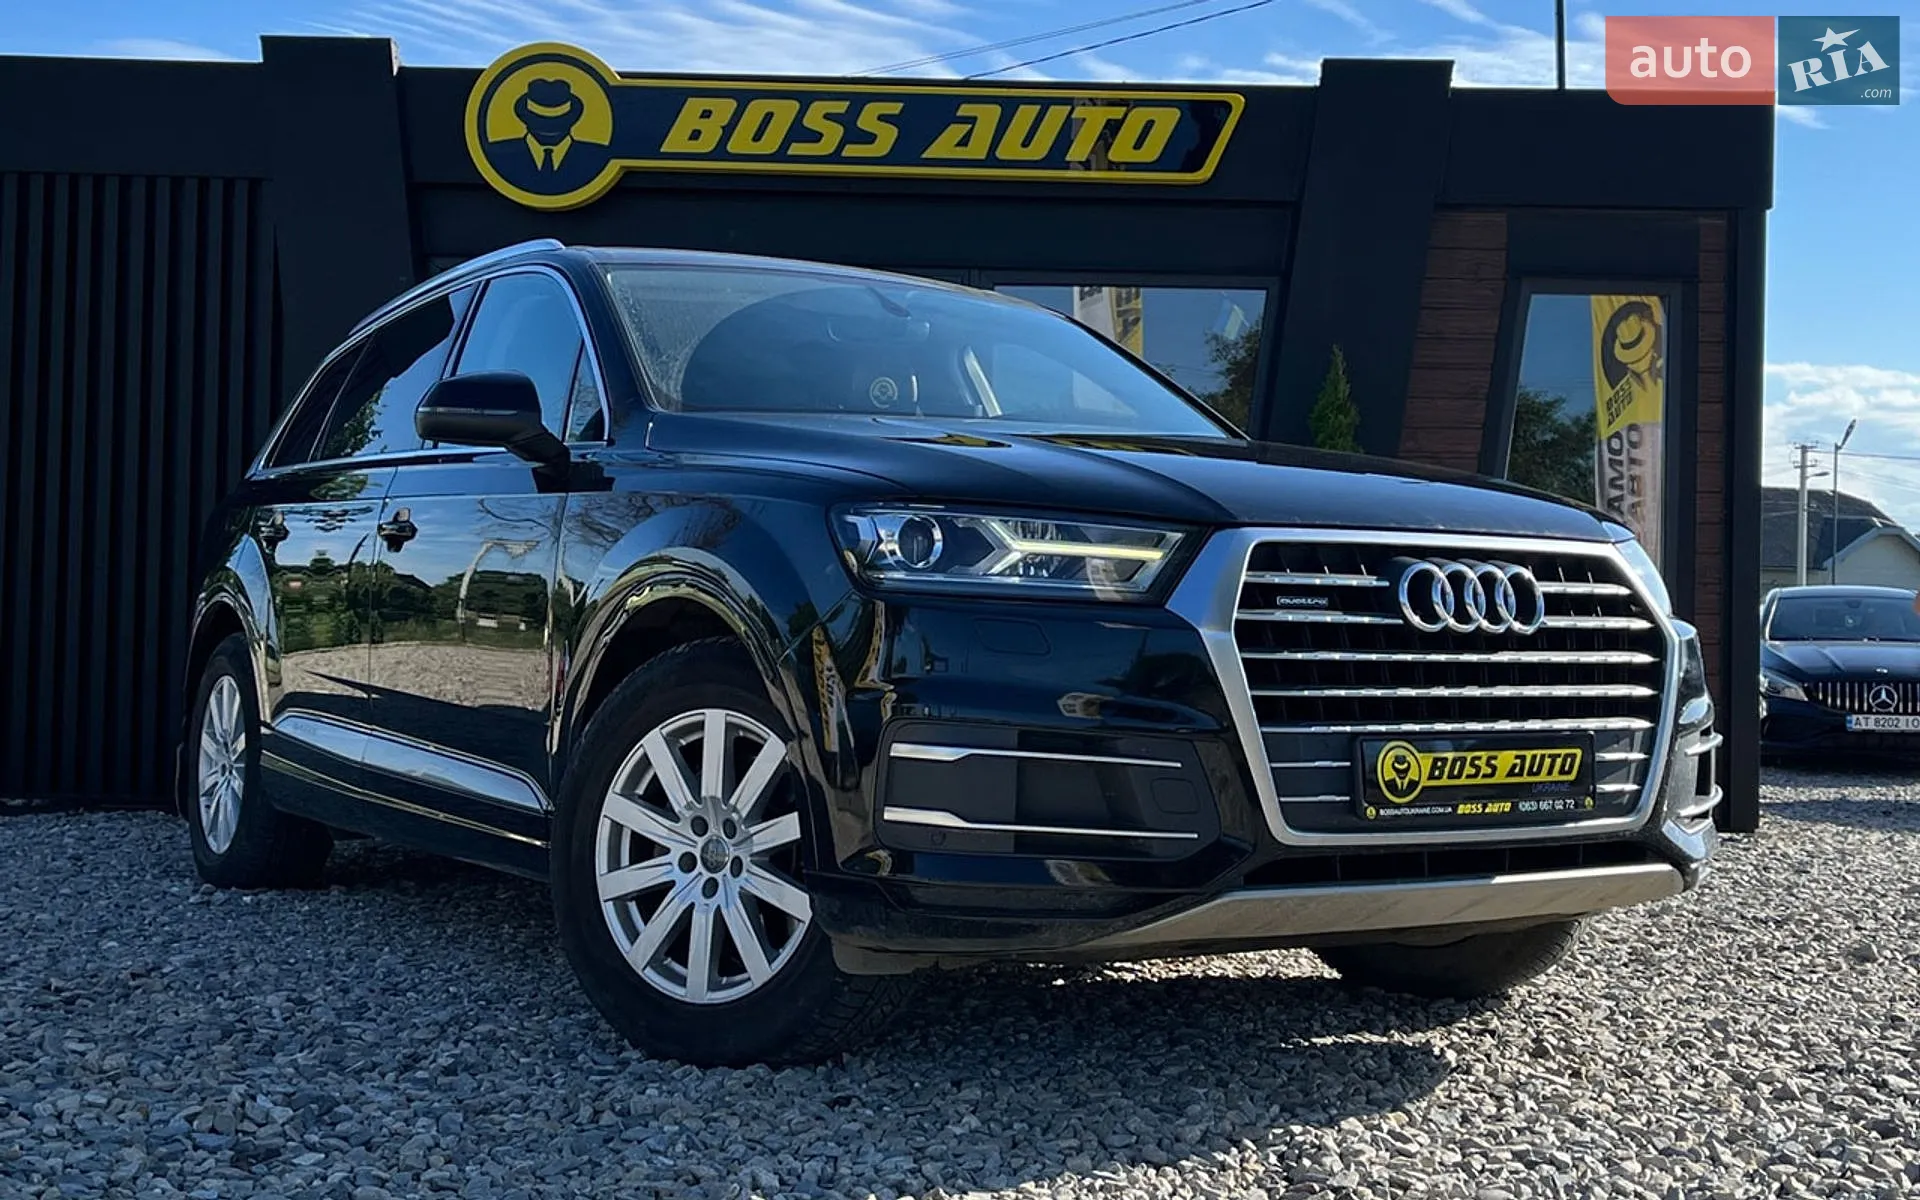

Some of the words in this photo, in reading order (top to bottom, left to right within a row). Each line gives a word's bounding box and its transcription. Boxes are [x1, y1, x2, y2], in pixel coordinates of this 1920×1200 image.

[660, 96, 905, 157] BOSS
[921, 102, 1182, 163] AUTO
[1854, 716, 1871, 728] AT
[1874, 716, 1900, 728] 8202
[1426, 754, 1499, 780] BOSS
[1505, 752, 1579, 778] AUTO
[1457, 803, 1483, 815] BOSS
[1484, 802, 1511, 813] AUTO
[1565, 799, 1575, 809] 72
